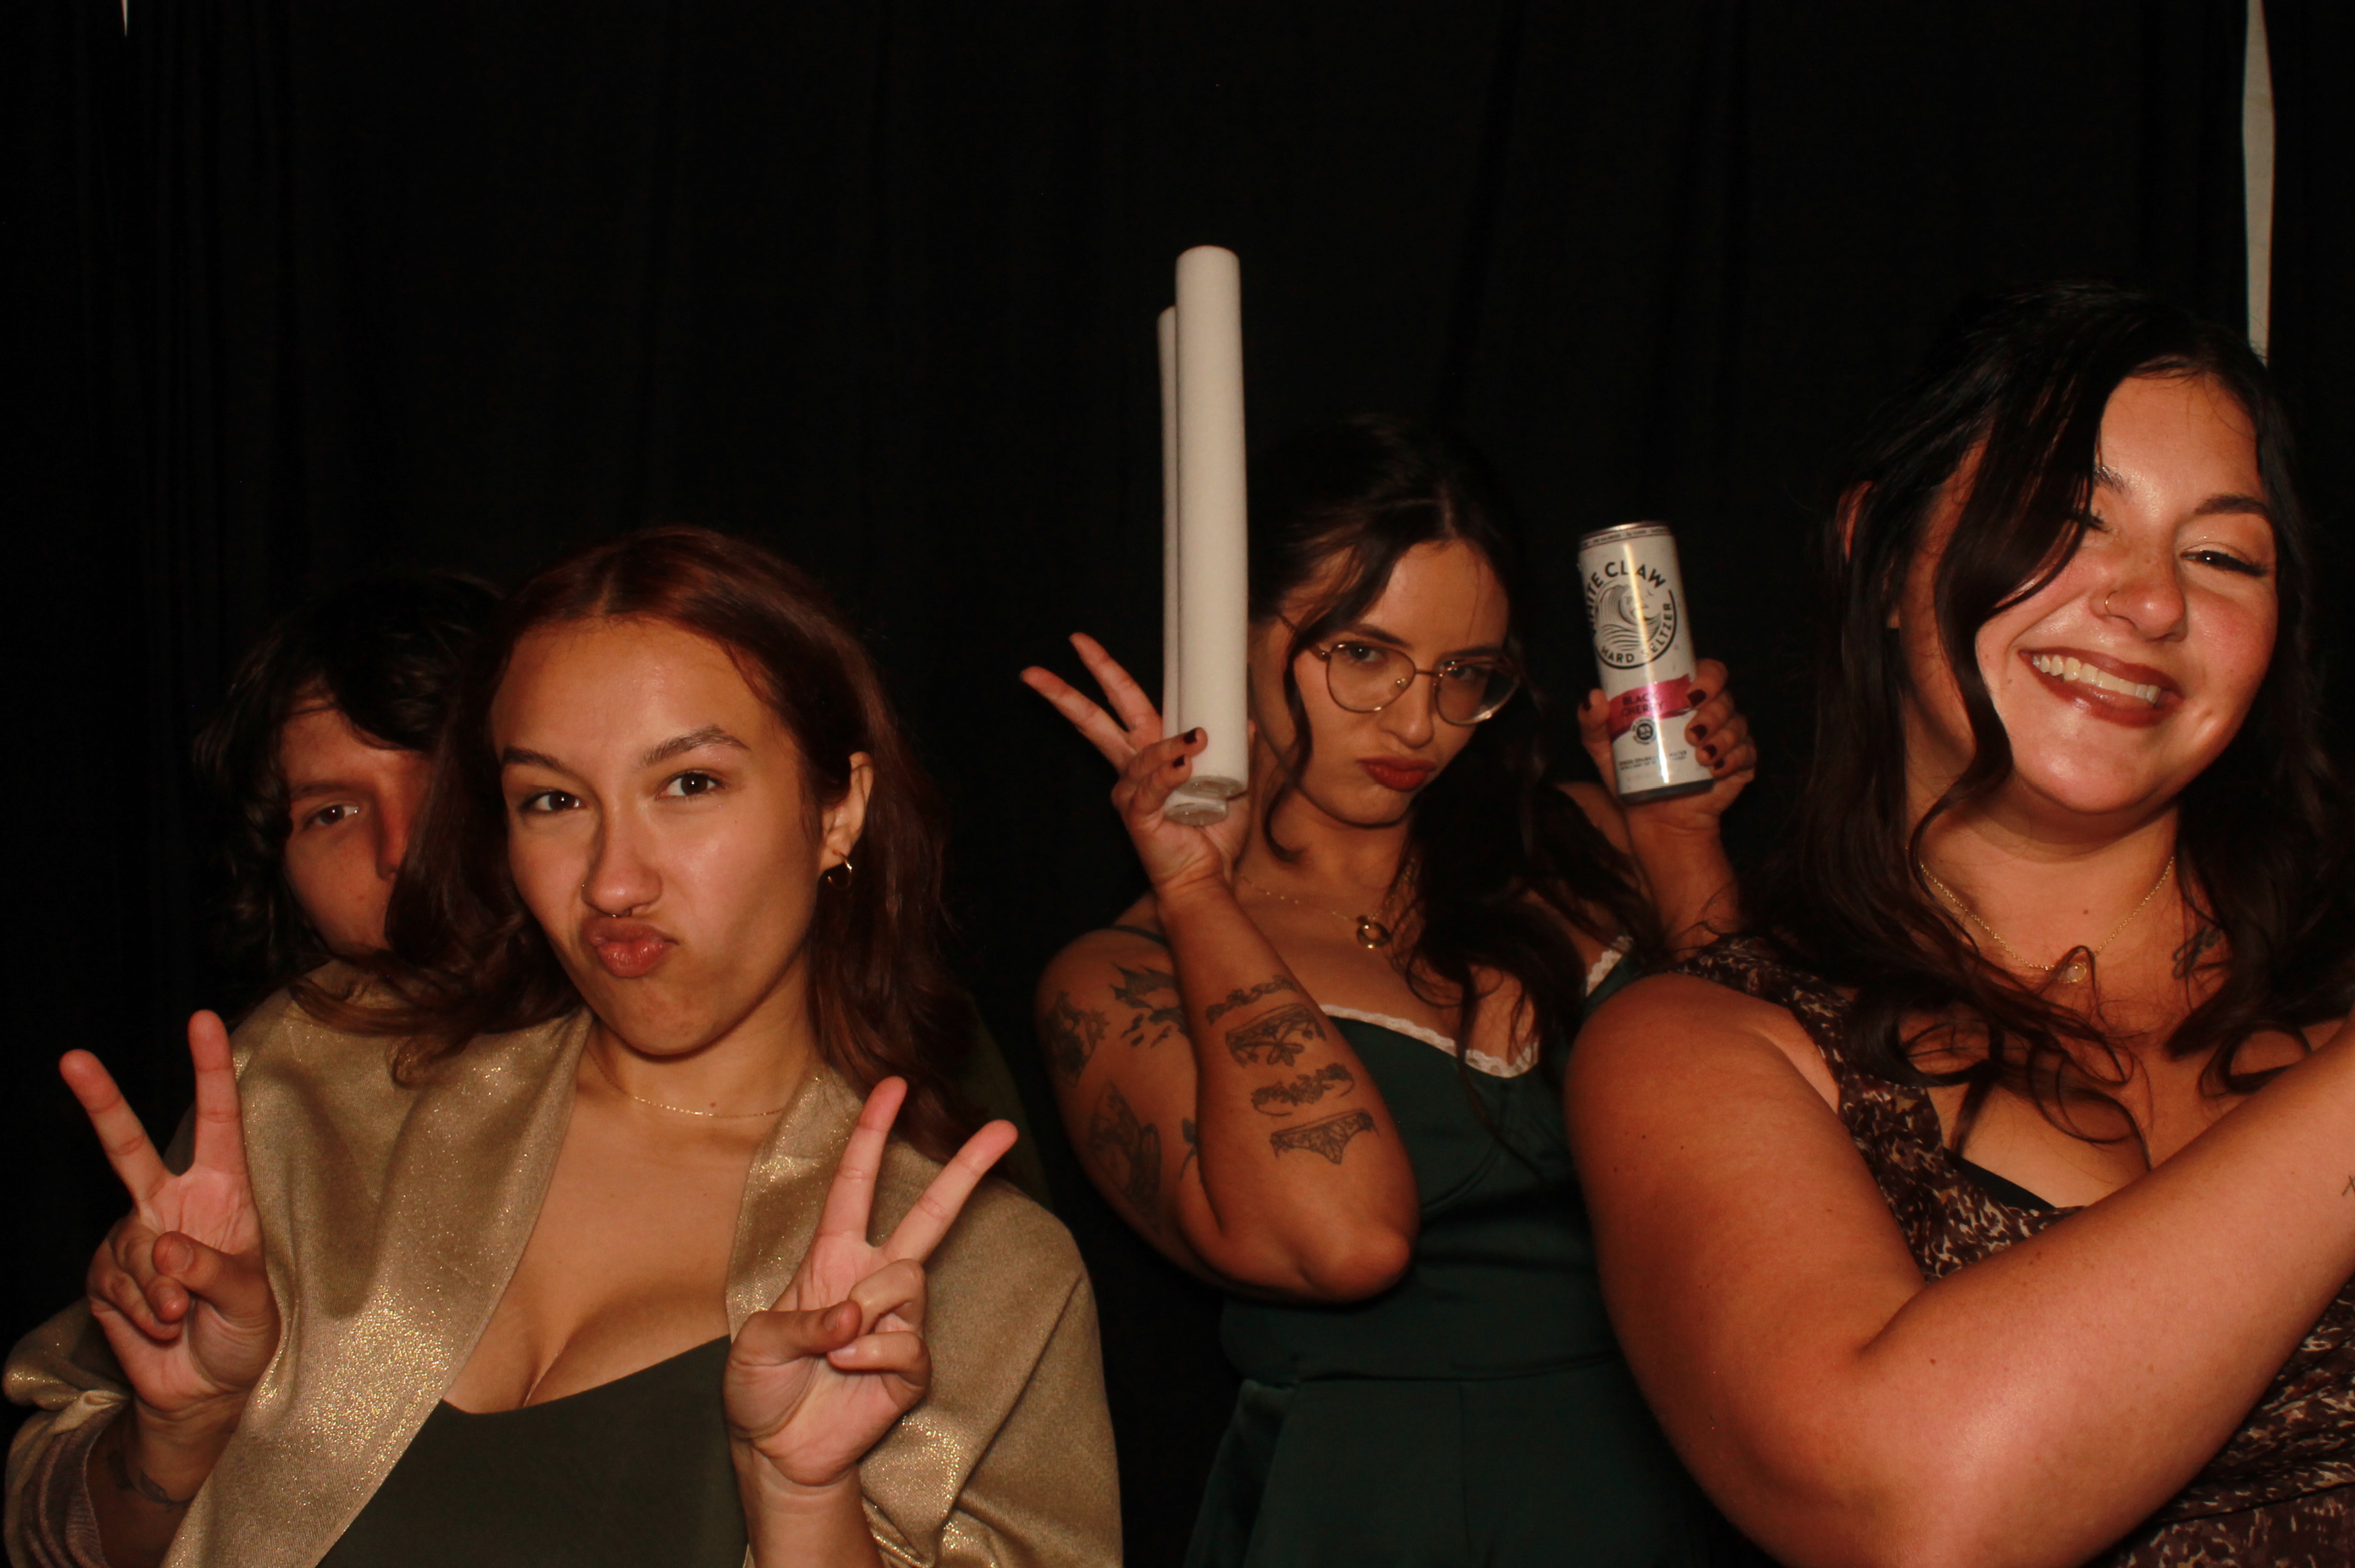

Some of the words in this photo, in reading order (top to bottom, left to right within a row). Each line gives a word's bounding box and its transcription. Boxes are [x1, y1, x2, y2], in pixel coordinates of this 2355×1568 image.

[1605, 561, 1666, 589] CLAW
[1601, 646, 1635, 664] HARD
[1642, 602, 1673, 657] ELTZER
[1621, 701, 1664, 717] CHERY
[1623, 692, 1658, 705] BLAC
